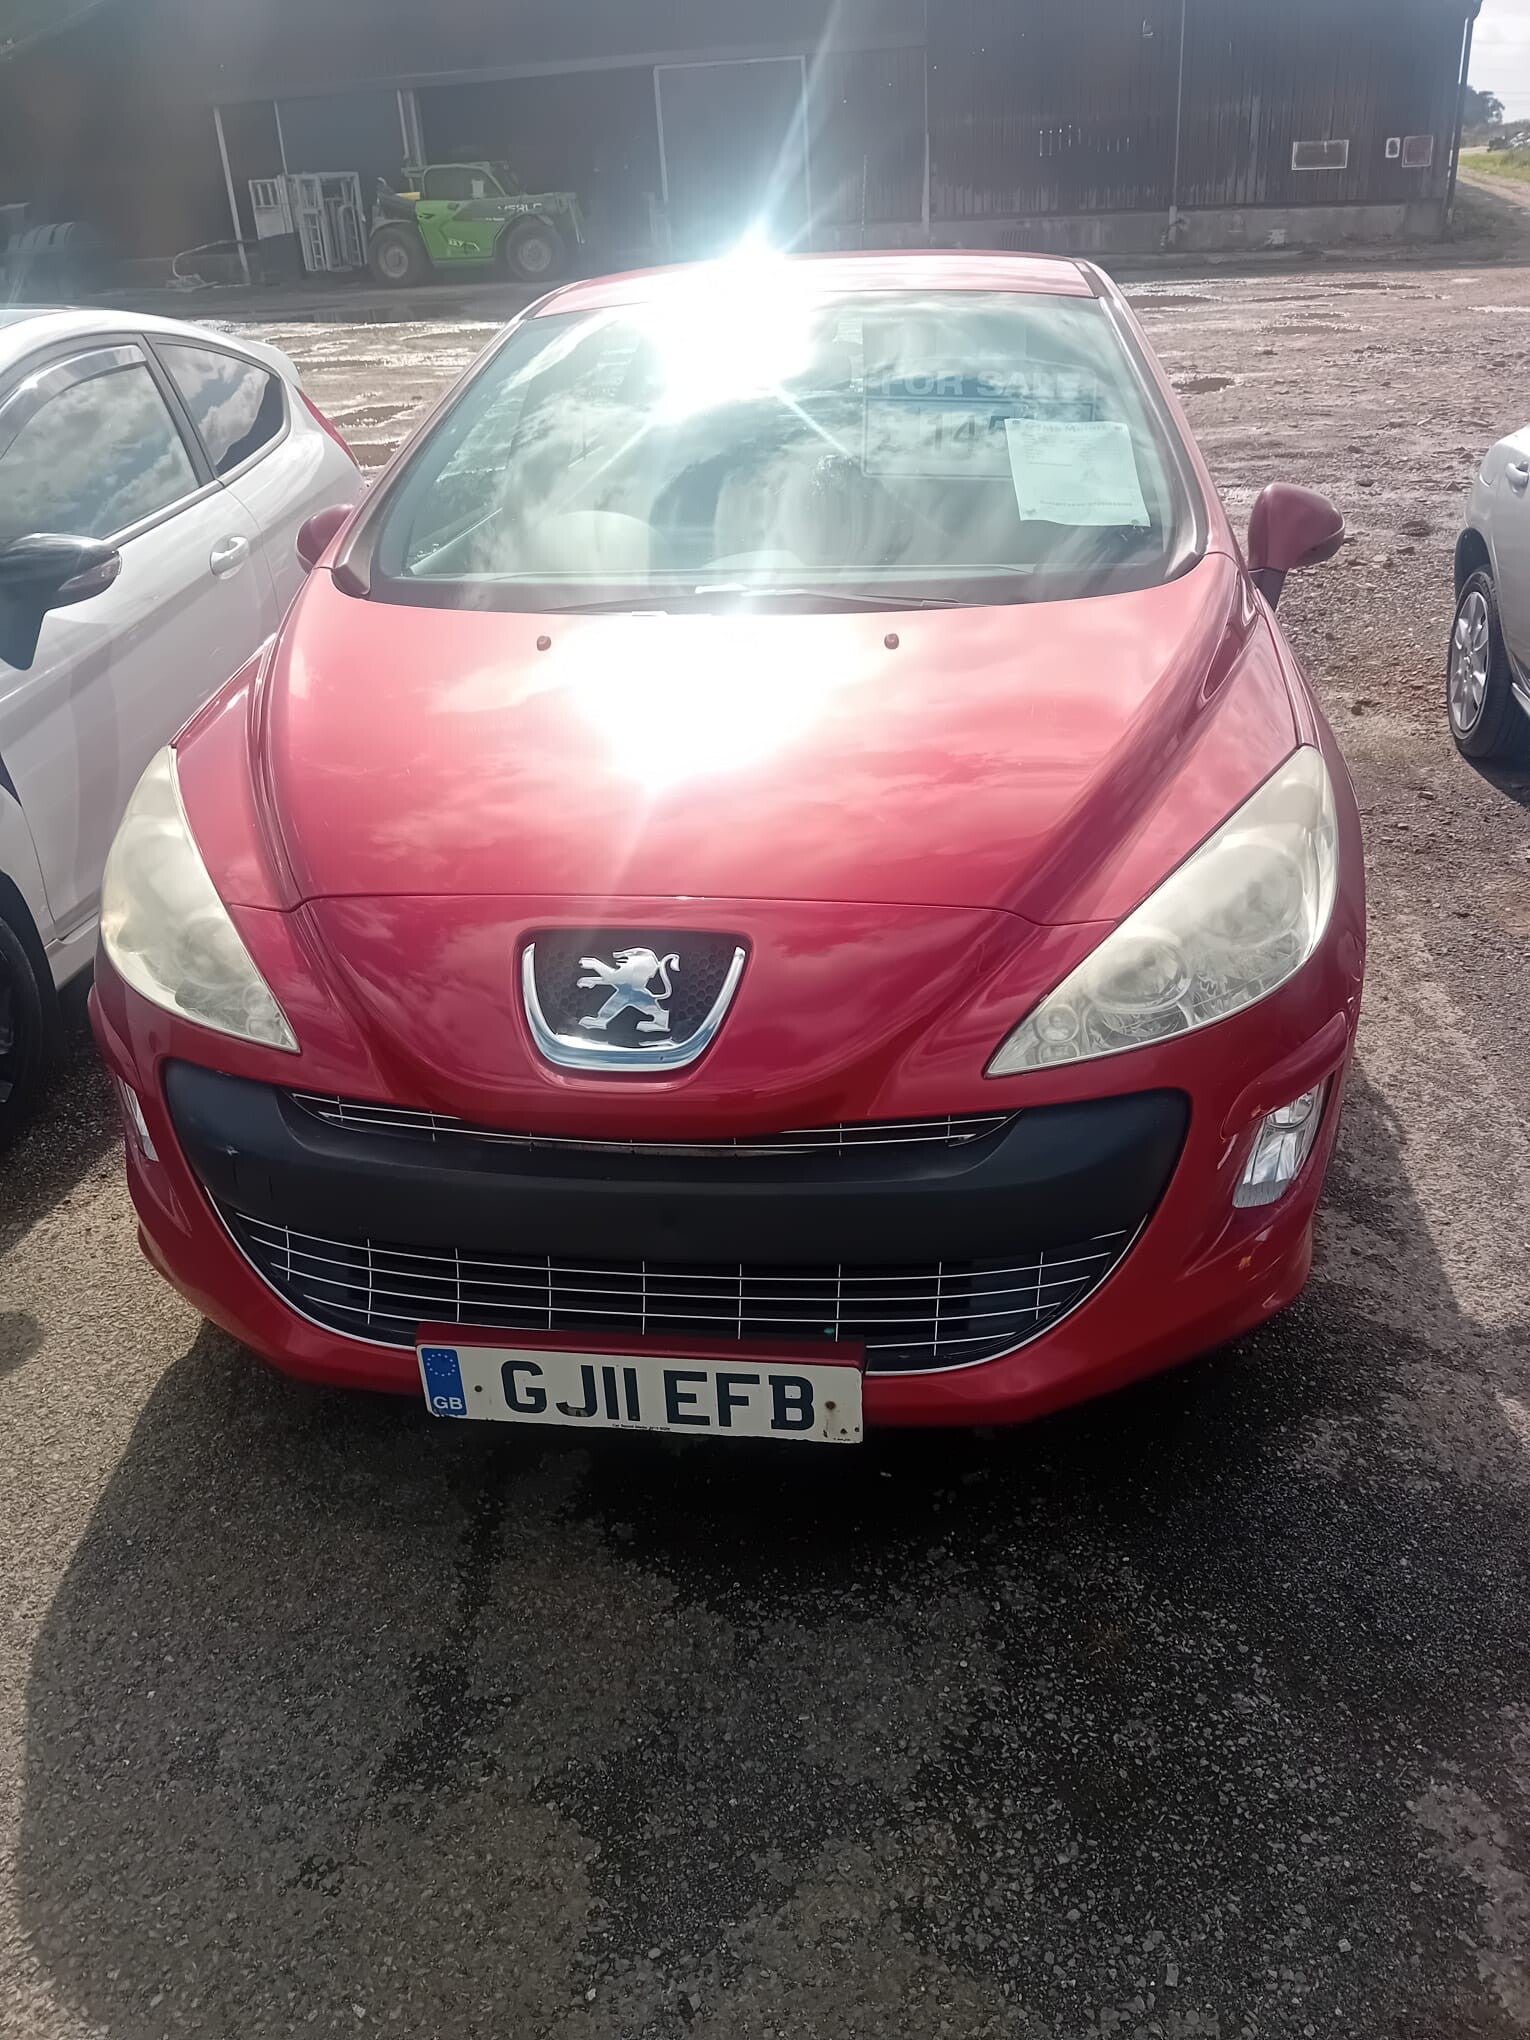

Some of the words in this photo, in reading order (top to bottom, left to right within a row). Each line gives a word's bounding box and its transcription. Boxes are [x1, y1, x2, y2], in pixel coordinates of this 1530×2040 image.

[880, 371, 965, 395] FOR
[976, 371, 1081, 399] SALE
[433, 1396, 463, 1410] GB
[663, 1369, 815, 1431] EFB
